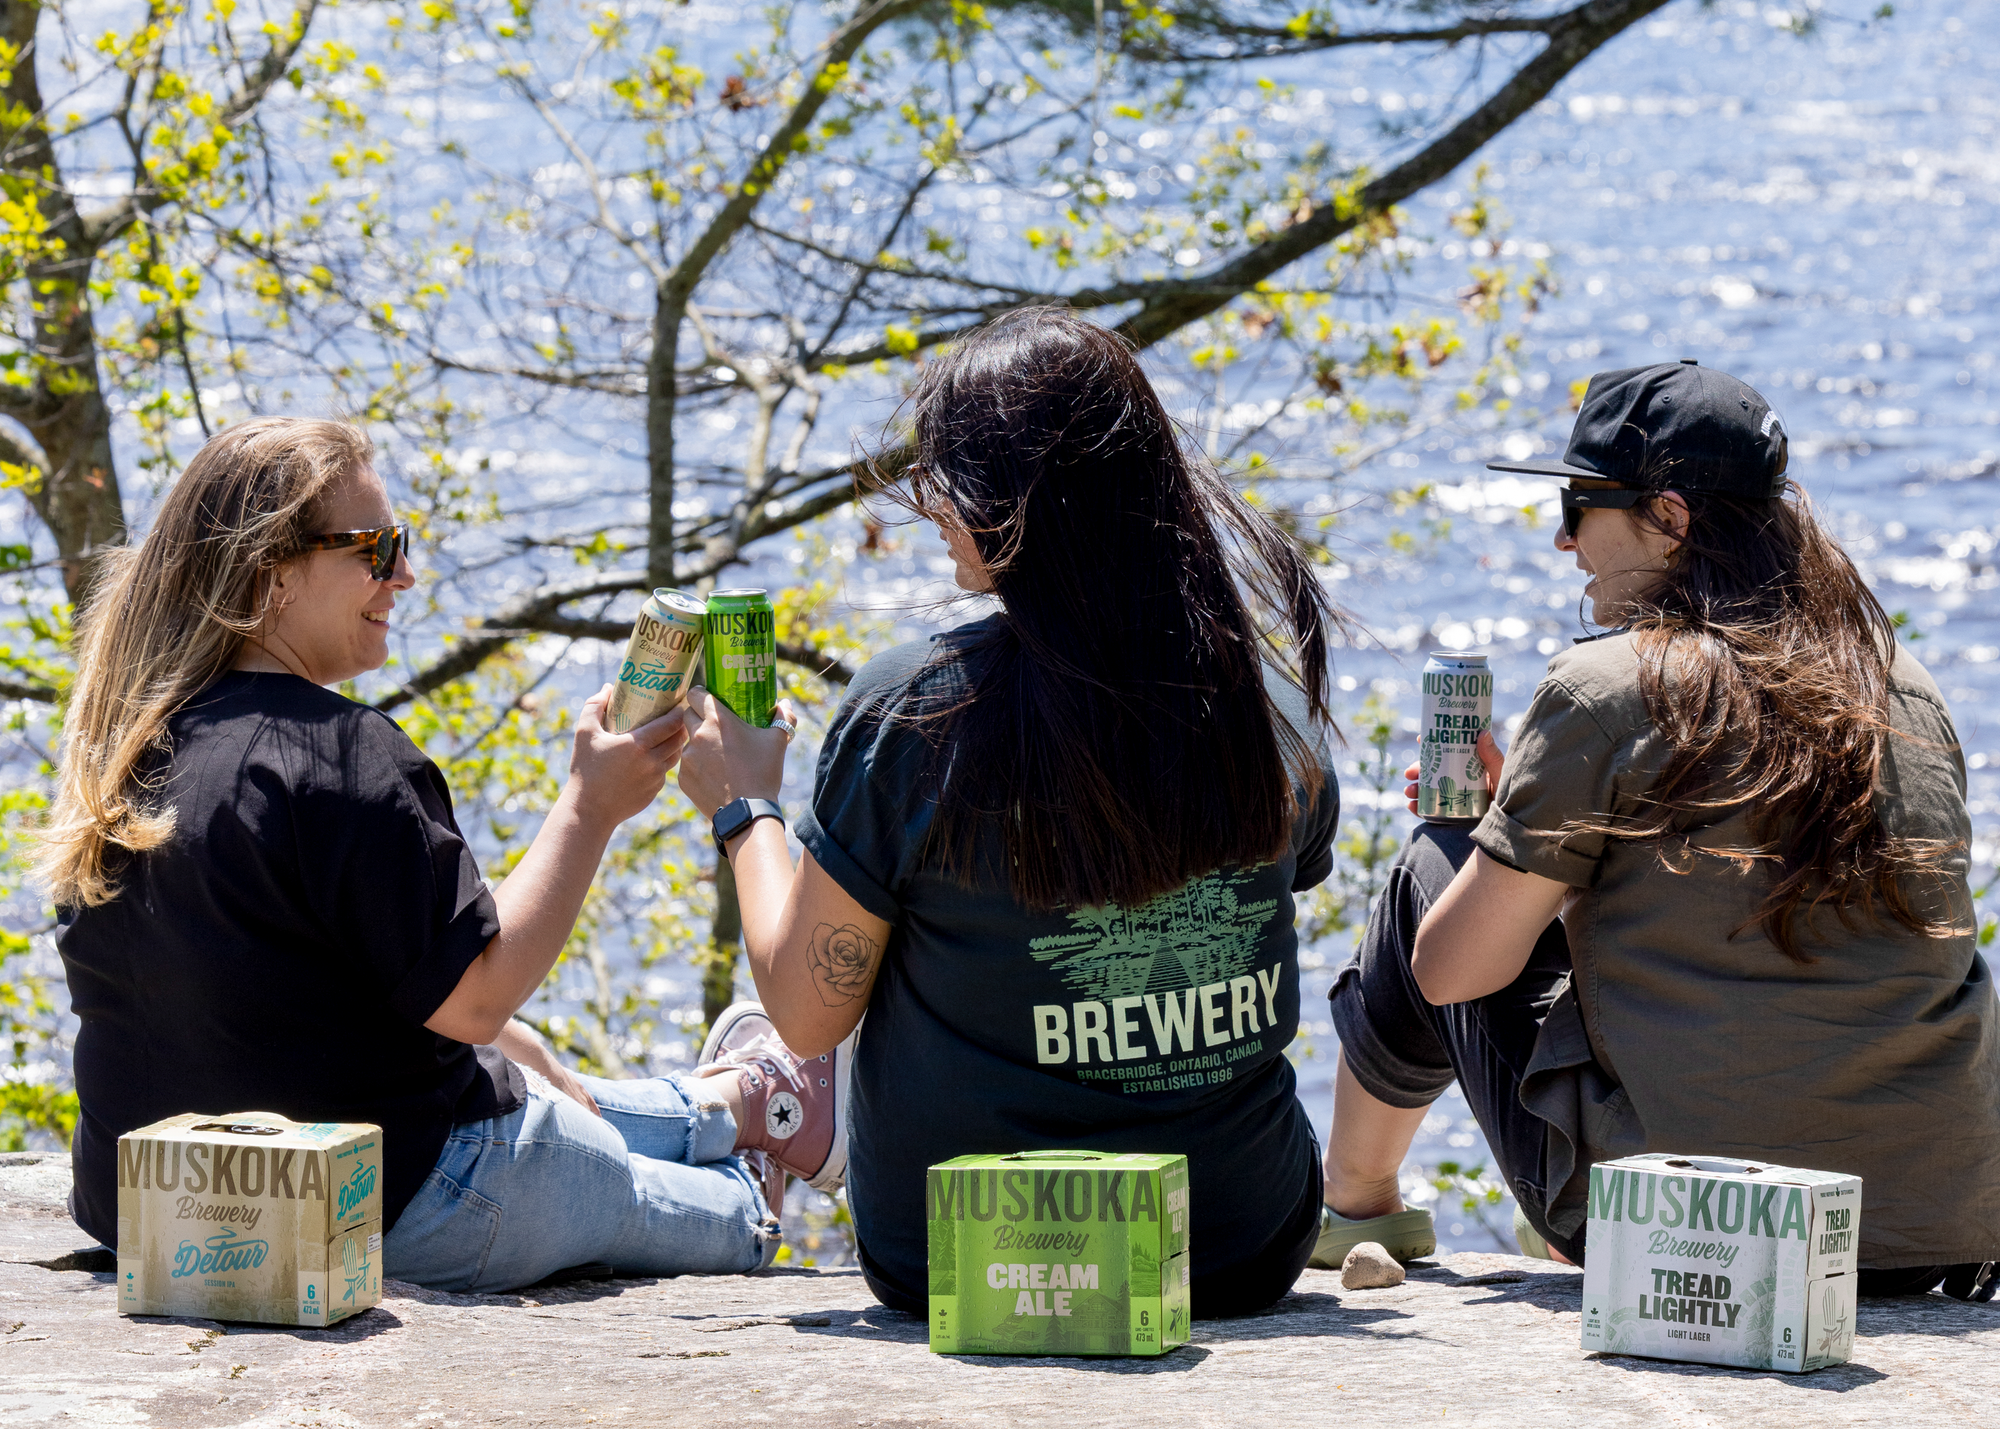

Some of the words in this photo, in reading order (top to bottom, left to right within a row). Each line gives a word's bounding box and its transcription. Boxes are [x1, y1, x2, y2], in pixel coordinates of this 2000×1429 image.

[635, 609, 704, 653] USKOK
[707, 609, 775, 635] MUSKOK
[639, 639, 677, 663] Brewery
[730, 636, 767, 649] Brewery
[721, 652, 774, 669] CREAM
[618, 656, 685, 692] Detour
[736, 667, 766, 683] ALE
[630, 687, 647, 699] SESSION
[1438, 697, 1478, 711] Brewery
[1434, 713, 1480, 729] TREAD
[1033, 962, 1282, 1064] BREWERY
[1077, 1062, 1167, 1080] BRACEBRIDGE,
[1170, 1053, 1225, 1073] ONTARIO,
[1226, 1039, 1263, 1063] CANADA
[1123, 1072, 1204, 1094] ESTABLISHED
[1206, 1067, 1233, 1085] 1996
[118, 1138, 326, 1200] MUSKOKA
[337, 1158, 377, 1221] Detour
[928, 1169, 1159, 1222] MUSKOKA
[1167, 1187, 1186, 1214] CREAM
[175, 1194, 262, 1230] Brewery
[1588, 1167, 1808, 1241] MUSKOKA
[1172, 1211, 1183, 1234] ALE
[1825, 1208, 1850, 1231] TREAD
[171, 1226, 269, 1279] Detour
[993, 1225, 1089, 1257] Brewery
[1647, 1229, 1740, 1268] Brewery
[1819, 1231, 1852, 1255] LIGHTLY
[204, 1279, 226, 1287] SESSION
[227, 1280, 236, 1288] IPA
[987, 1263, 1099, 1289] CREAM
[1651, 1268, 1732, 1300] TREAD
[307, 1284, 315, 1299] 6
[1014, 1290, 1073, 1317] ALE
[303, 1305, 312, 1314] 473
[1140, 1310, 1149, 1326] 6
[1638, 1294, 1742, 1329] LIGHTLY
[1136, 1333, 1146, 1342] 473
[1667, 1328, 1687, 1340] LIGHT
[1688, 1330, 1711, 1342] LAGER
[1783, 1327, 1792, 1343] 6
[1777, 1349, 1787, 1359] 473
[1787, 1350, 1795, 1359] mL
